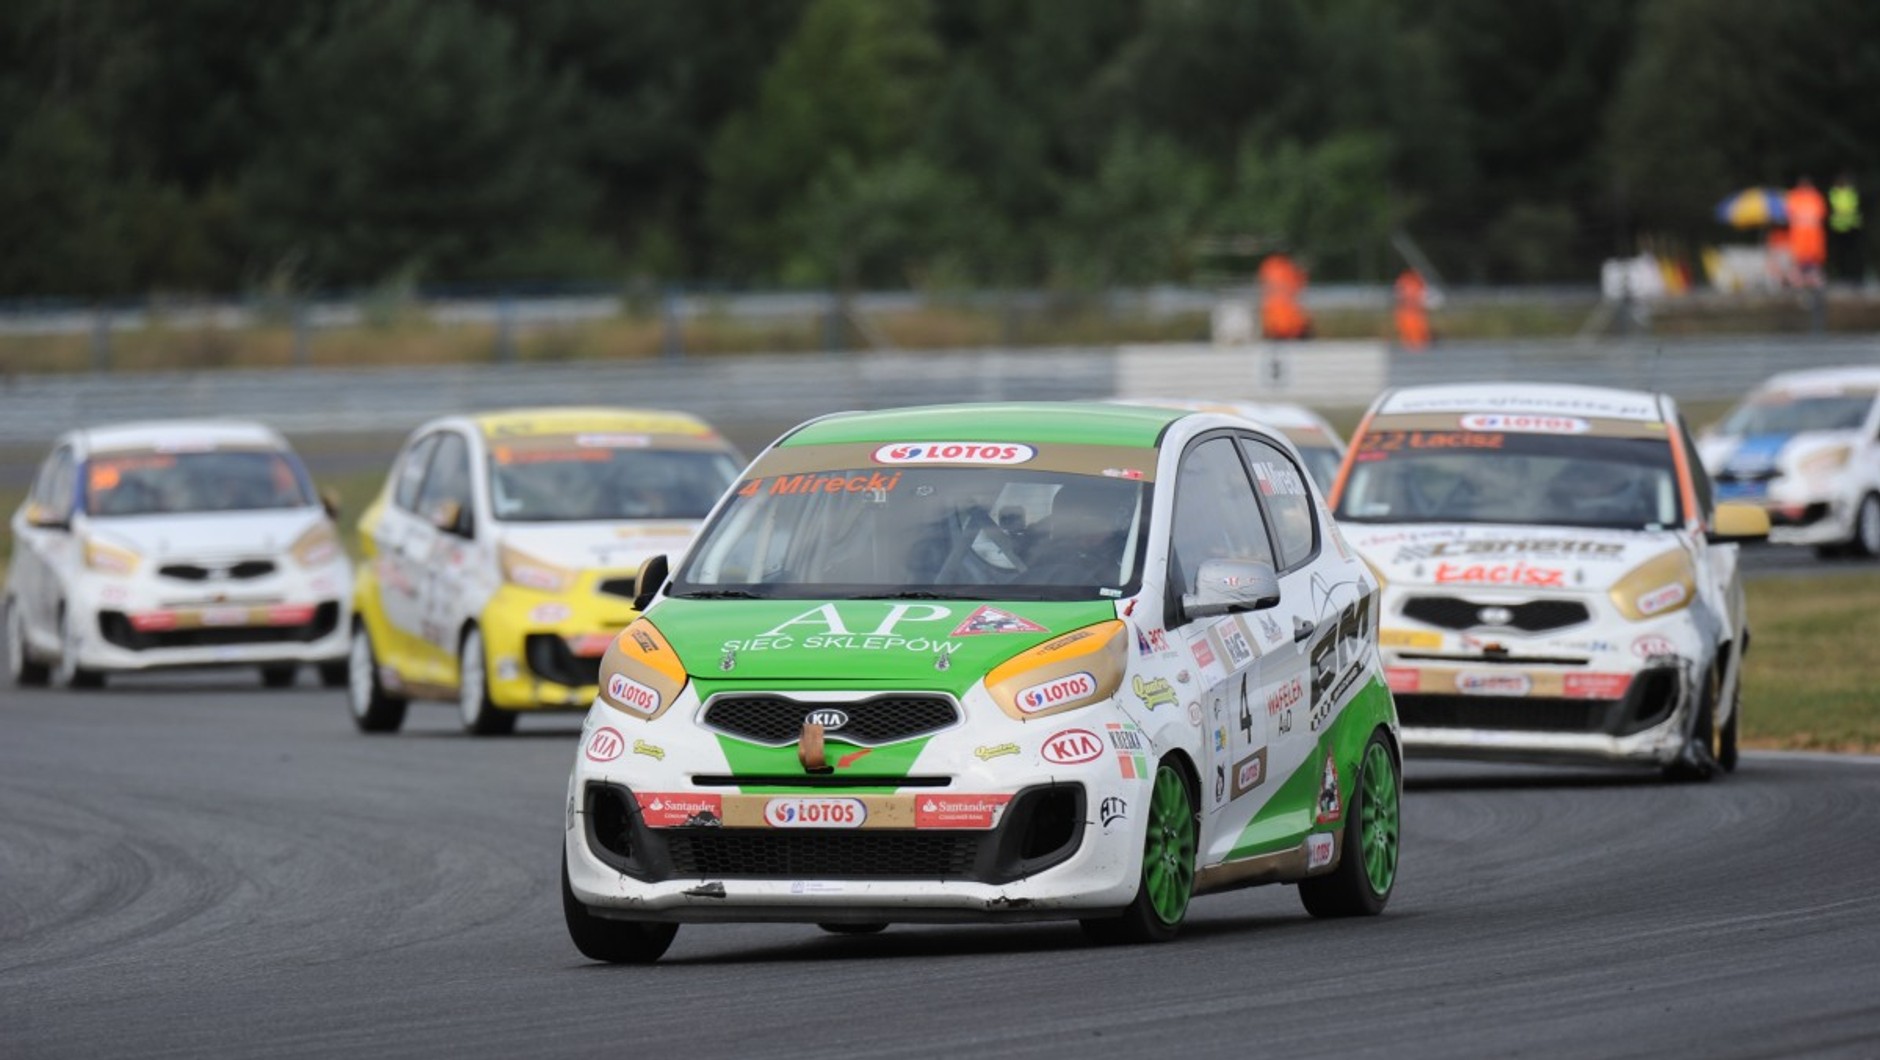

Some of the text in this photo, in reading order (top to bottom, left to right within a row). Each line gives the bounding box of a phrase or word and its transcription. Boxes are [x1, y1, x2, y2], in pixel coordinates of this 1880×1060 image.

[1503, 415, 1575, 431] LOTOS
[1362, 431, 1406, 449] 22
[926, 445, 1018, 460] LOTOS
[738, 471, 903, 497] 4 Mirecki
[756, 602, 952, 637] AP
[721, 635, 962, 654] SIEĆ SKLEPÓW
[621, 682, 654, 709] LOTOS
[1044, 677, 1089, 702] LOTOS
[1239, 671, 1253, 744] 4
[812, 713, 841, 725] KIA
[591, 734, 617, 757] KIA
[1052, 736, 1097, 759] KIA
[664, 800, 716, 812] Santander
[799, 803, 854, 822] LOTOS
[939, 801, 993, 812] Santander
[1101, 797, 1128, 822] ATT
